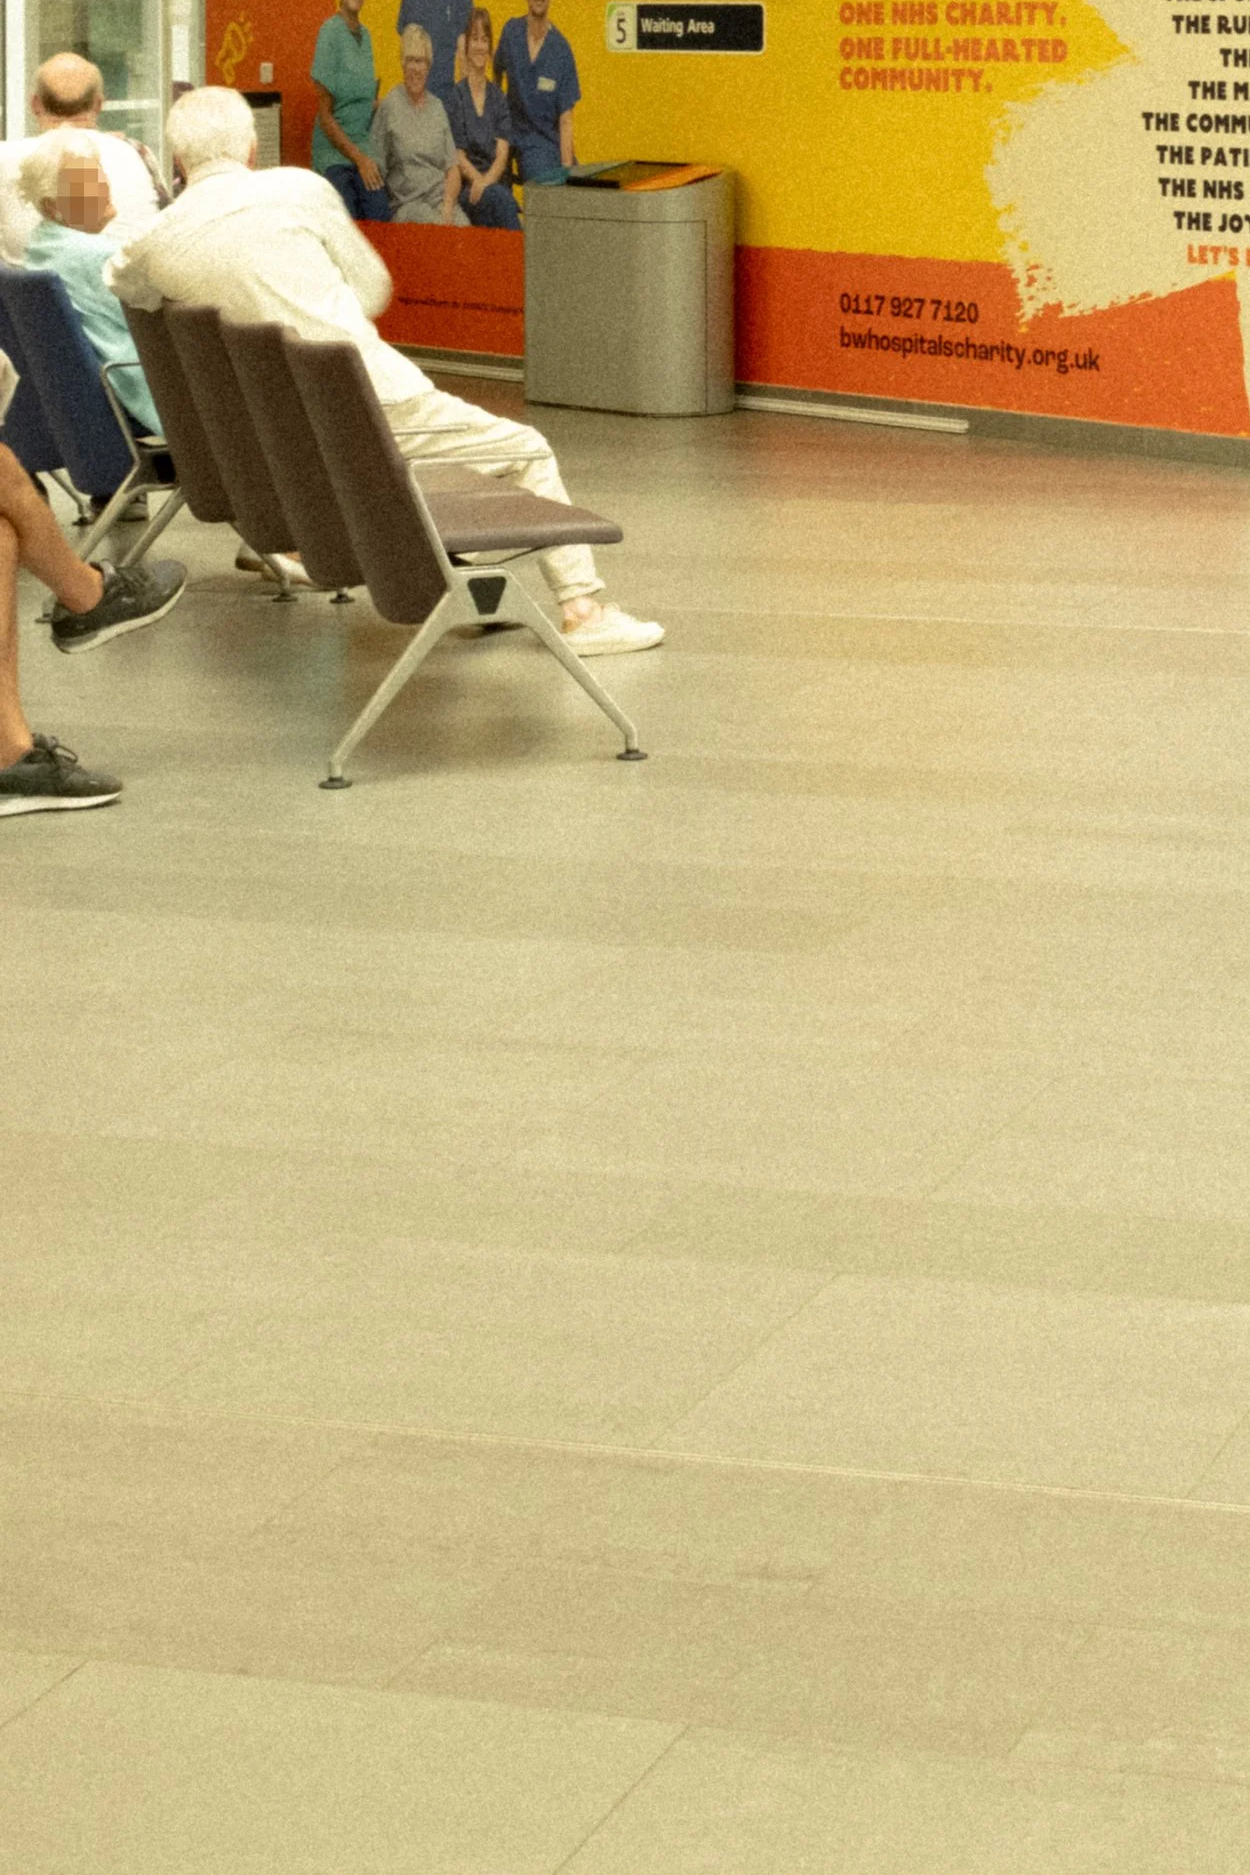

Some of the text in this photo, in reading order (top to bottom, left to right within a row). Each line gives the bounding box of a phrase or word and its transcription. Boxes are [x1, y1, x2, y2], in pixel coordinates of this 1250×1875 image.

[839, 1, 1067, 28] ONE NHS CHARITY.
[1172, 15, 1211, 35] THE
[616, 17, 715, 43] 5 Waiting Area
[839, 36, 1068, 63] ONE FULL-HEARTED
[839, 66, 993, 93] COMMUNITY.
[1188, 81, 1227, 100] THE
[1142, 112, 1180, 132] THE
[1156, 145, 1194, 165] THE
[1158, 177, 1197, 198] THE
[1203, 179, 1244, 200] NHS
[1173, 211, 1212, 232] THE
[1187, 244, 1239, 267] LET'S
[839, 292, 979, 324] 0117 927 7120
[839, 326, 1101, 374] bwhospitalscharity.org.uk
